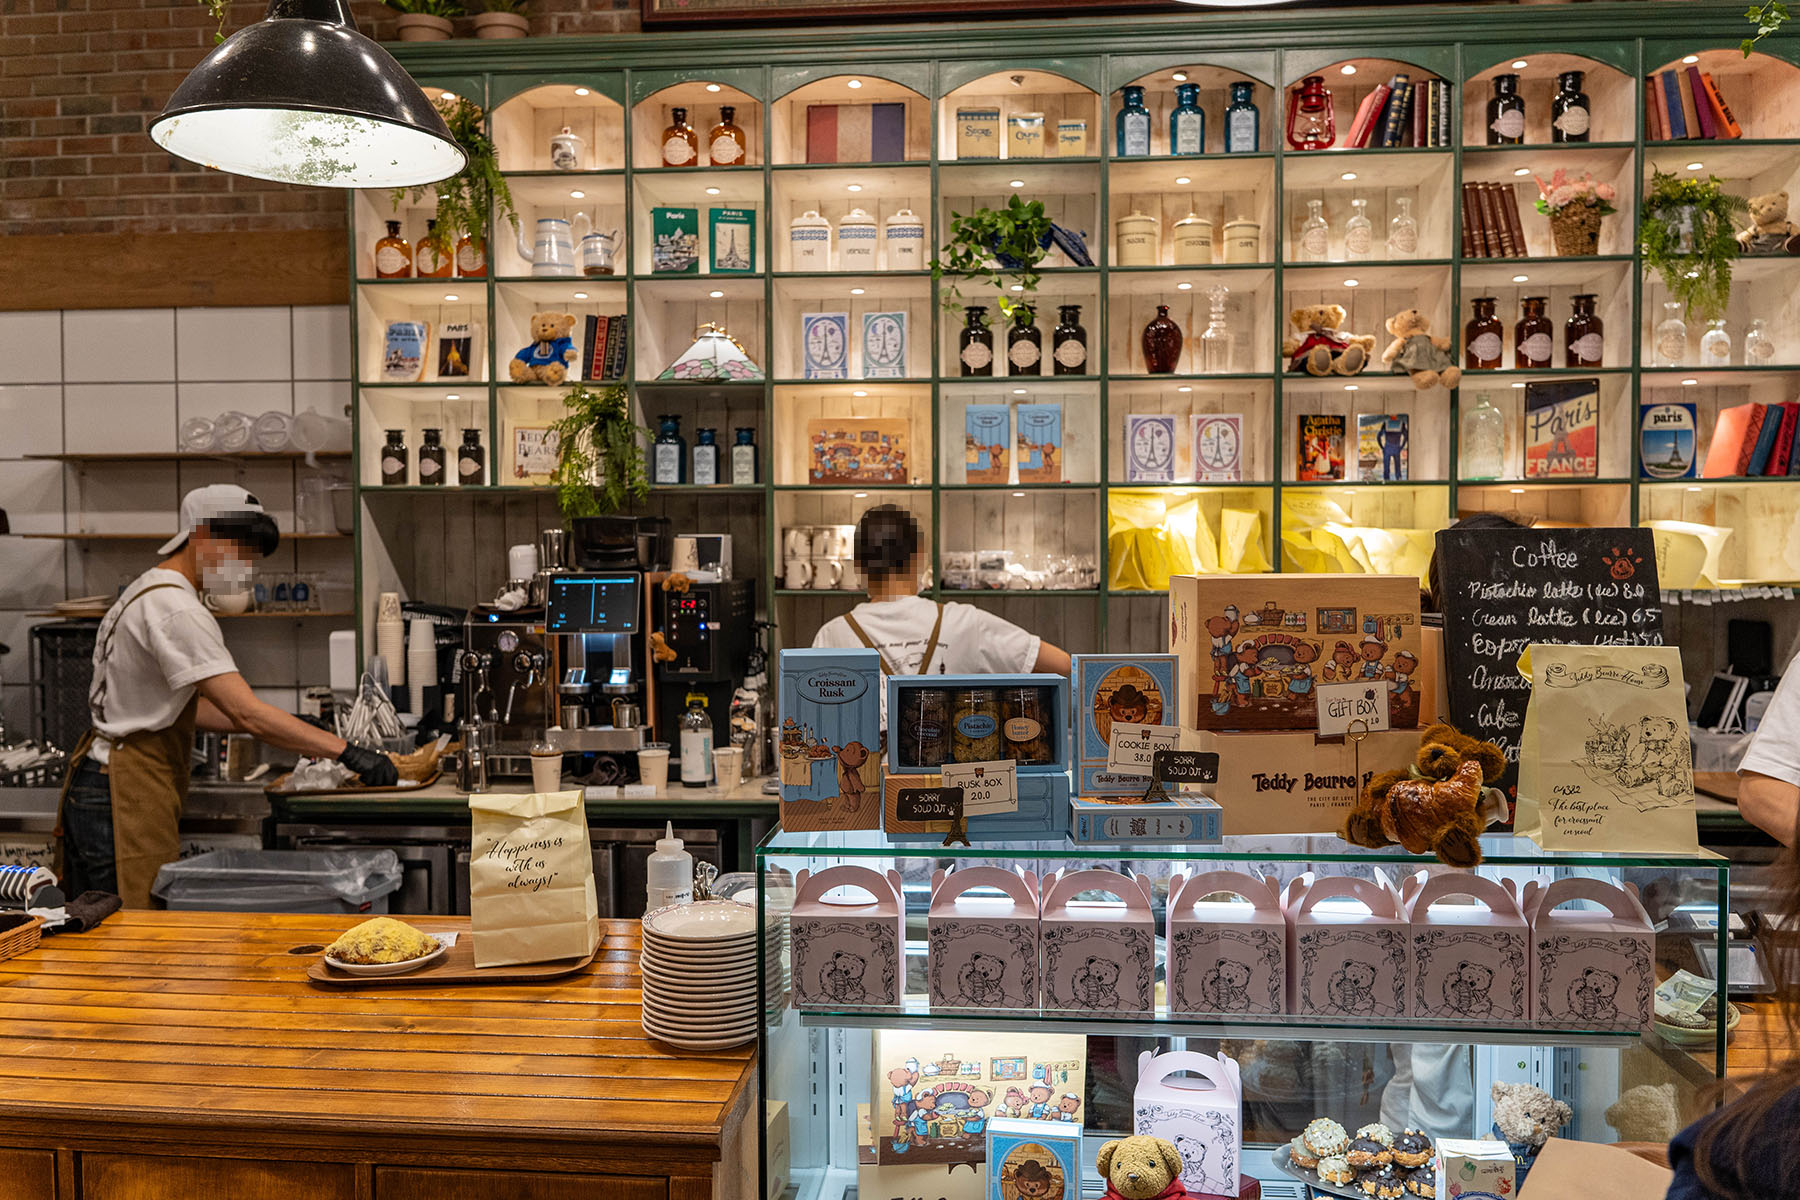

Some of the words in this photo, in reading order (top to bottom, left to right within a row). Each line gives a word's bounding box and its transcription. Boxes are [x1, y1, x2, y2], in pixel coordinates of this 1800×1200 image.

[1306, 415, 1341, 427] Agatha
[1530, 399, 1597, 442] Paris
[1653, 411, 1684, 425] paris
[1304, 426, 1342, 436] Christie
[1527, 456, 1596, 474] FRANCE
[1512, 539, 1580, 568] Coffee
[1623, 583, 1645, 599] 8.0
[1632, 607, 1662, 623] 6.5
[808, 677, 857, 688] Croissant
[819, 687, 845, 698] Rusk
[1328, 700, 1353, 718] GIFT
[1356, 698, 1379, 716] BOX
[1118, 740, 1150, 751] COOKIE
[1153, 742, 1171, 752] BOX
[1133, 753, 1152, 762] 38.0
[1173, 755, 1196, 766] SORRY
[1167, 766, 1187, 776] SOLD
[1188, 767, 1202, 777] OUT
[957, 780, 981, 790] RUSK
[983, 778, 1003, 787] BOX
[1096, 774, 1115, 783] Teddy
[1252, 772, 1299, 793] Teddy
[1303, 772, 1357, 791] Beurre
[918, 793, 941, 802] SORRY
[970, 791, 991, 801] 20.0
[912, 805, 932, 813] SOLD
[934, 804, 946, 813] OUT
[1548, 798, 1568, 812] The
[1569, 800, 1587, 812] best
[1586, 802, 1609, 814] place
[1553, 815, 1566, 827] for
[553, 836, 564, 847] is
[505, 856, 533, 873] with
